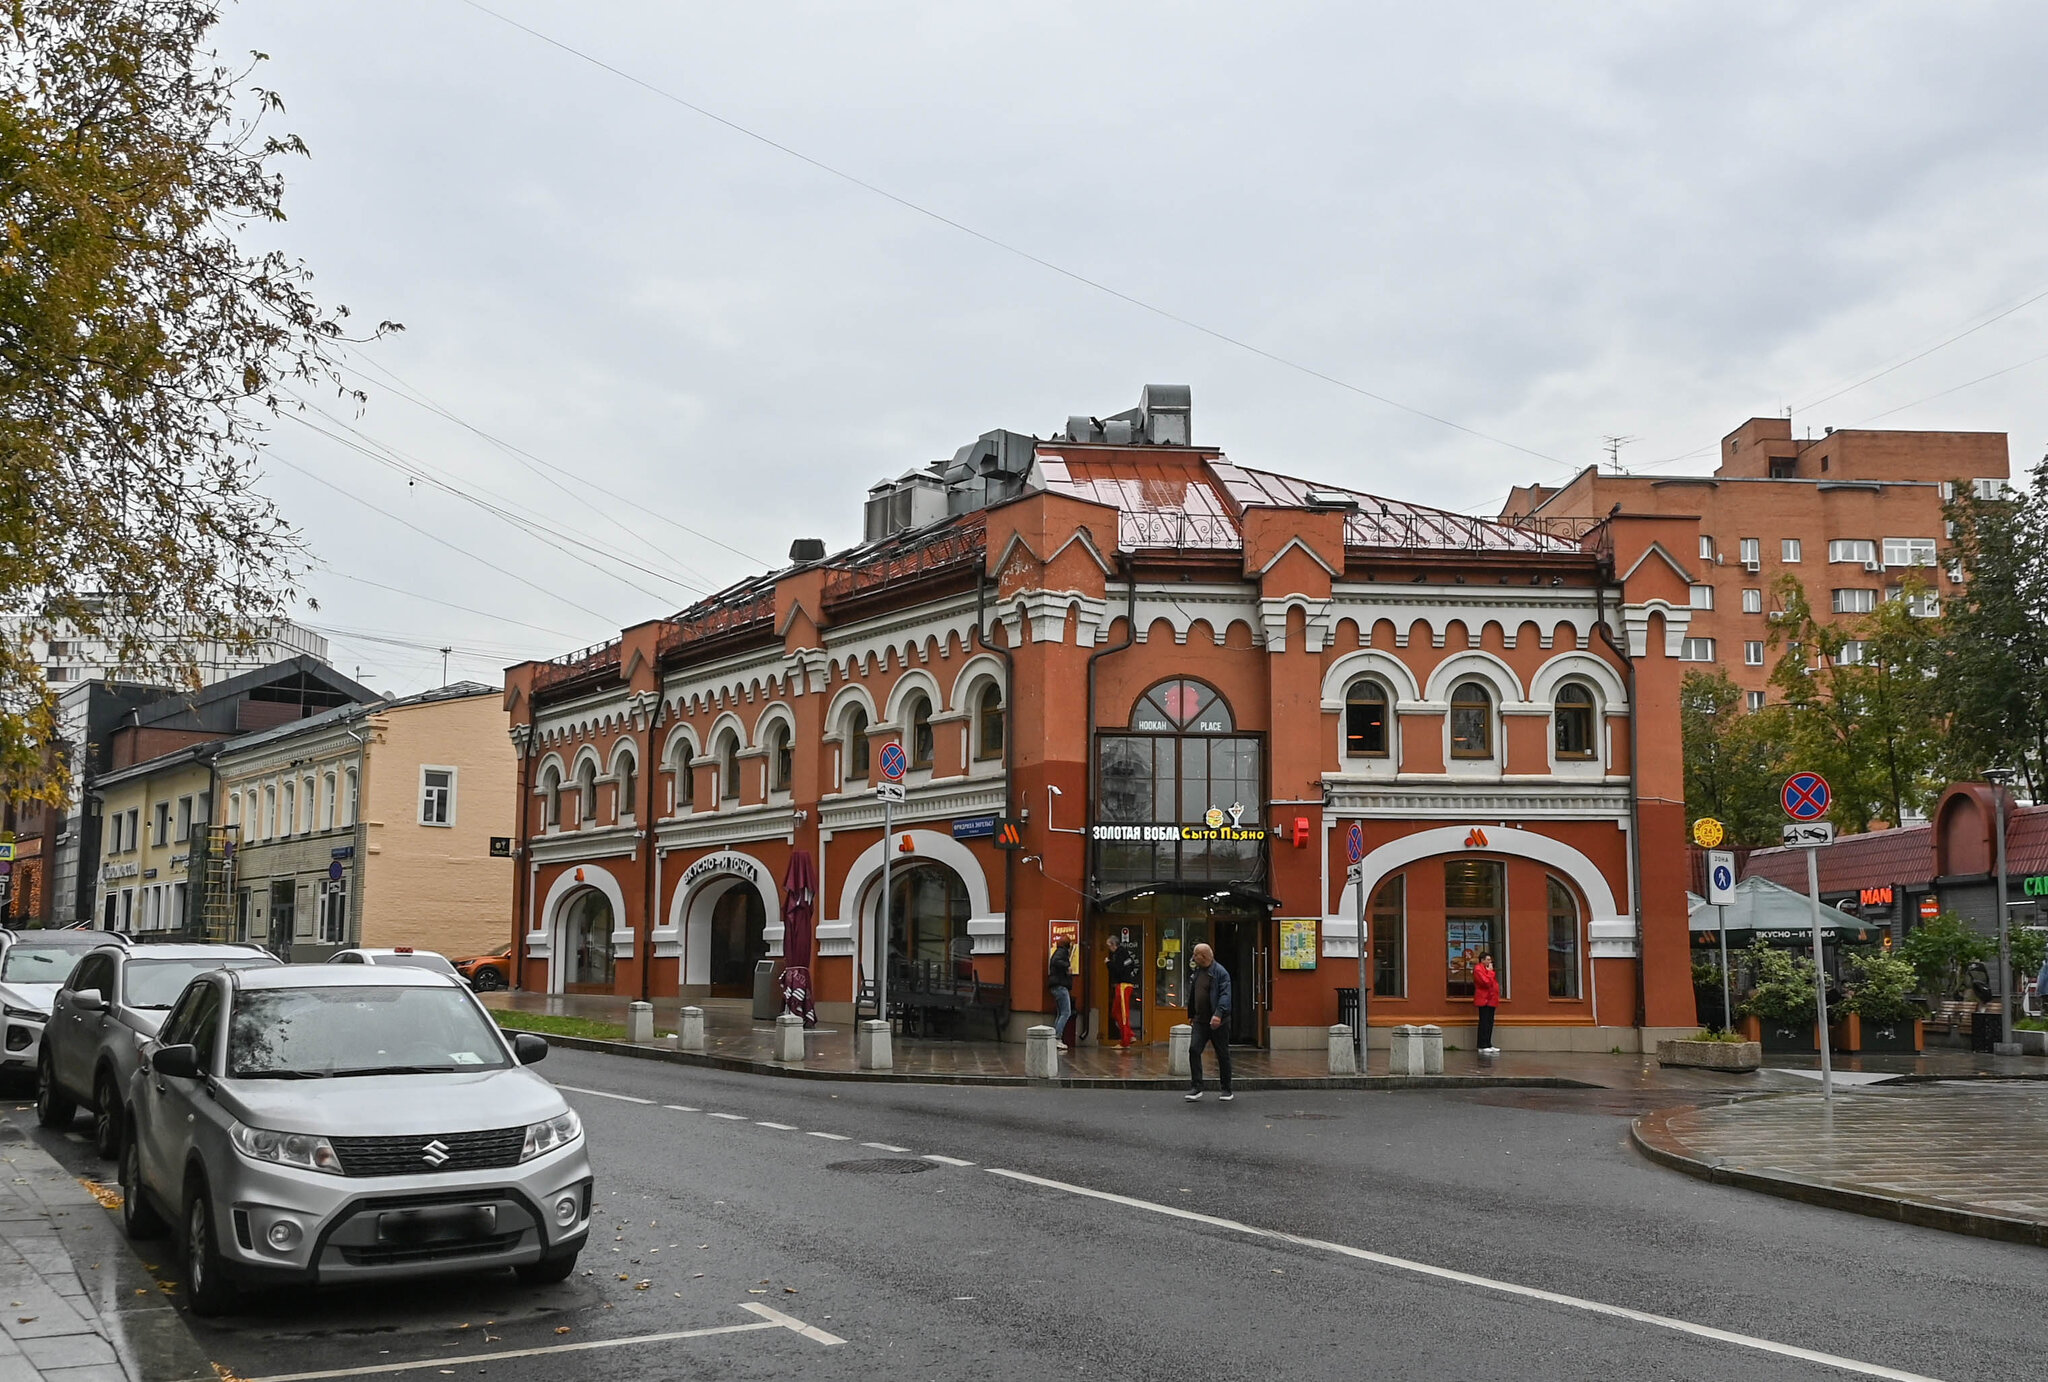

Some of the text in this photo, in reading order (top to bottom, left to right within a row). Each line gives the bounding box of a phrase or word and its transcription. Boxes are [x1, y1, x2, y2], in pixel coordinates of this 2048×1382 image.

[1138, 720, 1222, 731] HOOKAH PLACE
[1695, 819, 1722, 833] ЗОЛОТАЯ
[1703, 827, 1713, 835] 24
[1093, 826, 1181, 841] ЗОЛОТАЯ ВОБЛА
[730, 858, 756, 882] ТОЧКА
